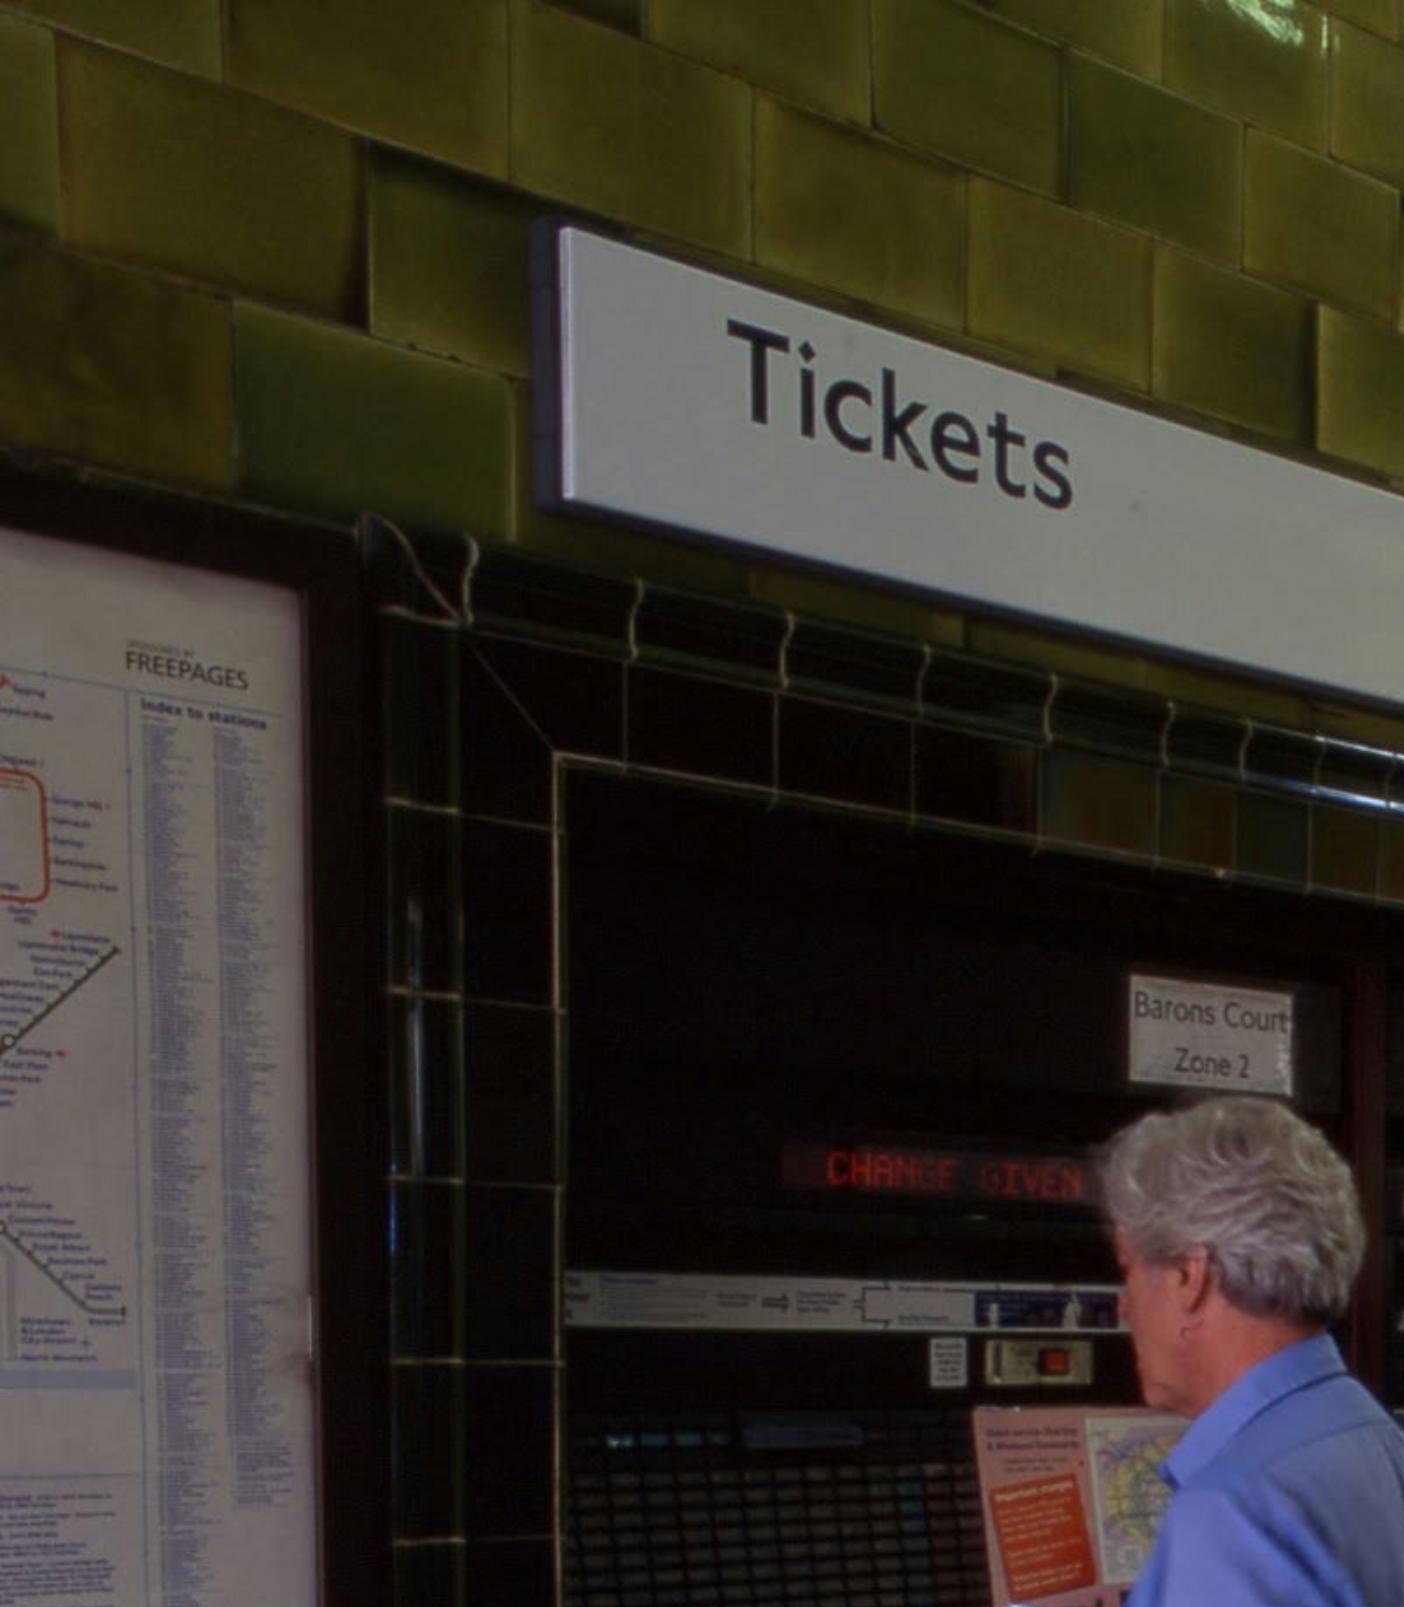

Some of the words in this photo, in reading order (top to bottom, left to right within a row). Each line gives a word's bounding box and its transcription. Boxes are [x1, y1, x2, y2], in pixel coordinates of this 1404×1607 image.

[727, 319, 1073, 510] Tickets
[125, 651, 249, 690] FREEPAGES
[140, 698, 181, 716] Index
[187, 706, 203, 719] to
[208, 711, 267, 731] stations
[1134, 991, 1216, 1025] Barons
[1224, 1002, 1289, 1034] Court
[1175, 1047, 1232, 1077] Zone
[1238, 1054, 1251, 1079] 2
[826, 1148, 957, 1192] CHANGE
[981, 1158, 1085, 1200] GIVEN
